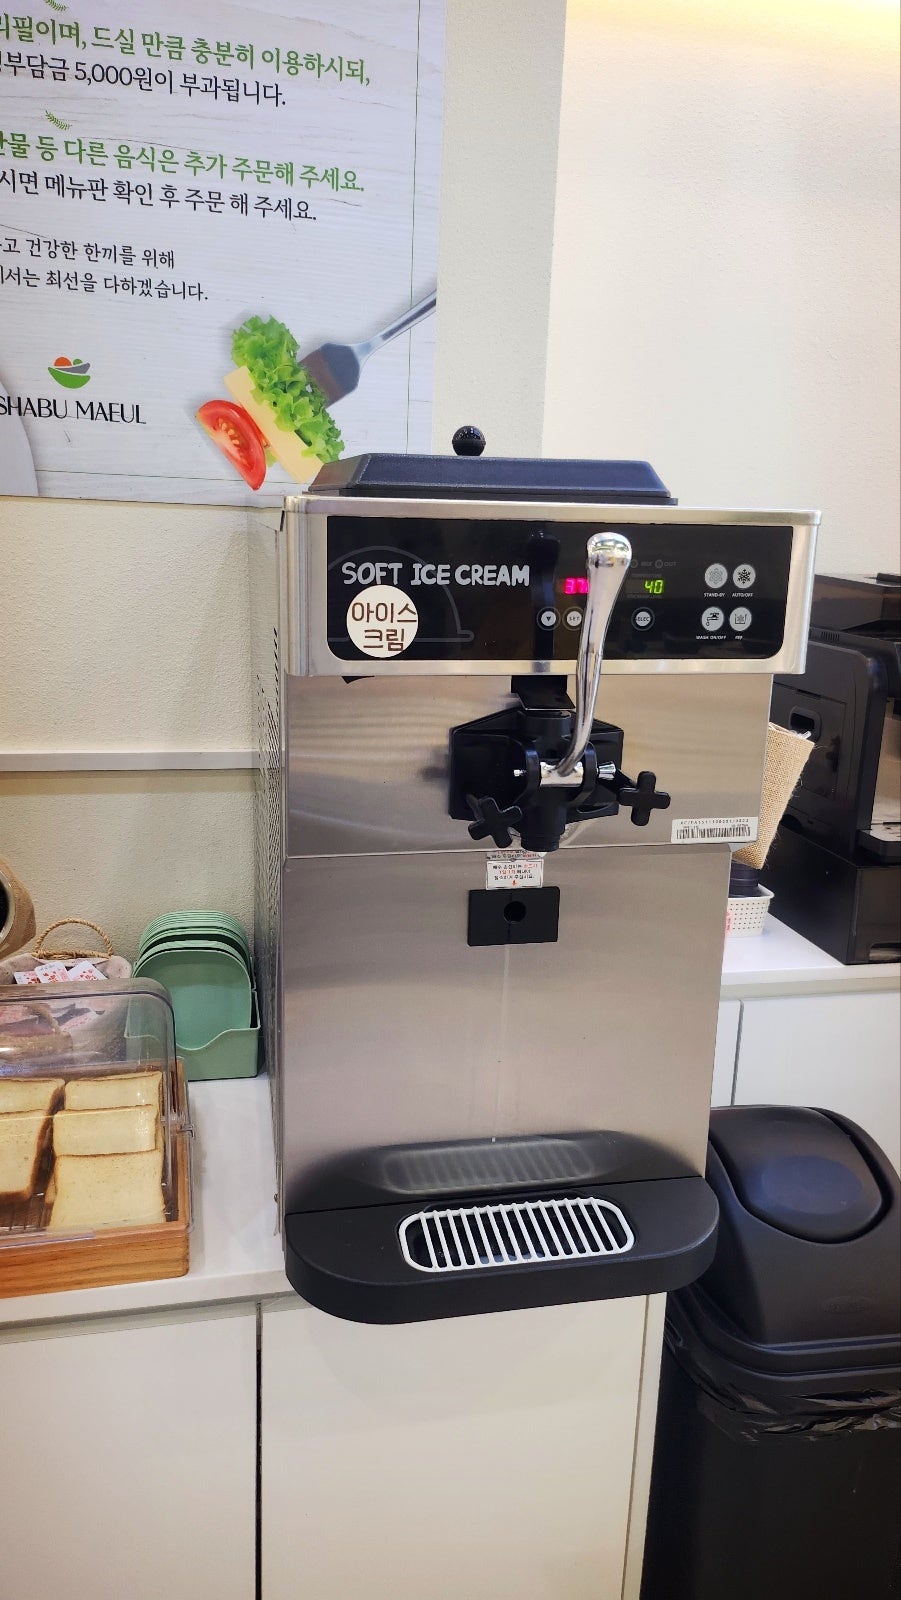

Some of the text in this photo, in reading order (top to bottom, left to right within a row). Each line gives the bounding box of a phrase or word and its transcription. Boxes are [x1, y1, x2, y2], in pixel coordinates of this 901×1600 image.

[91, 27, 135, 55] 드실
[141, 31, 186, 61] 만큼
[191, 37, 254, 70] 충분히
[262, 47, 370, 87] 이용하시되,
[75, 62, 174, 95] 5,000원이
[180, 73, 286, 107] 부과됩니다.
[36, 135, 59, 162] 등
[64, 138, 108, 166] 다른
[113, 144, 179, 174] 음식은
[184, 151, 228, 180] 추가
[232, 157, 294, 188] 주문해
[299, 165, 365, 192] 주세요.
[44, 173, 109, 202] 메뉴판
[113, 180, 154, 206] 확인
[160, 184, 180, 208] 후
[184, 188, 225, 213] 주문
[229, 192, 249, 217] 해
[254, 196, 317, 221] 주세요.
[0, 237, 175, 269] 고 건강한 한끼를 위해
[0, 265, 208, 301] 서는 최선을 다하겠습니다.
[0, 395, 147, 424] SHABU MAEUL
[342, 561, 531, 588] SOFT ICE CREAM
[644, 579, 664, 594] 40
[351, 601, 418, 623] 아이스
[363, 628, 406, 652] 크림
